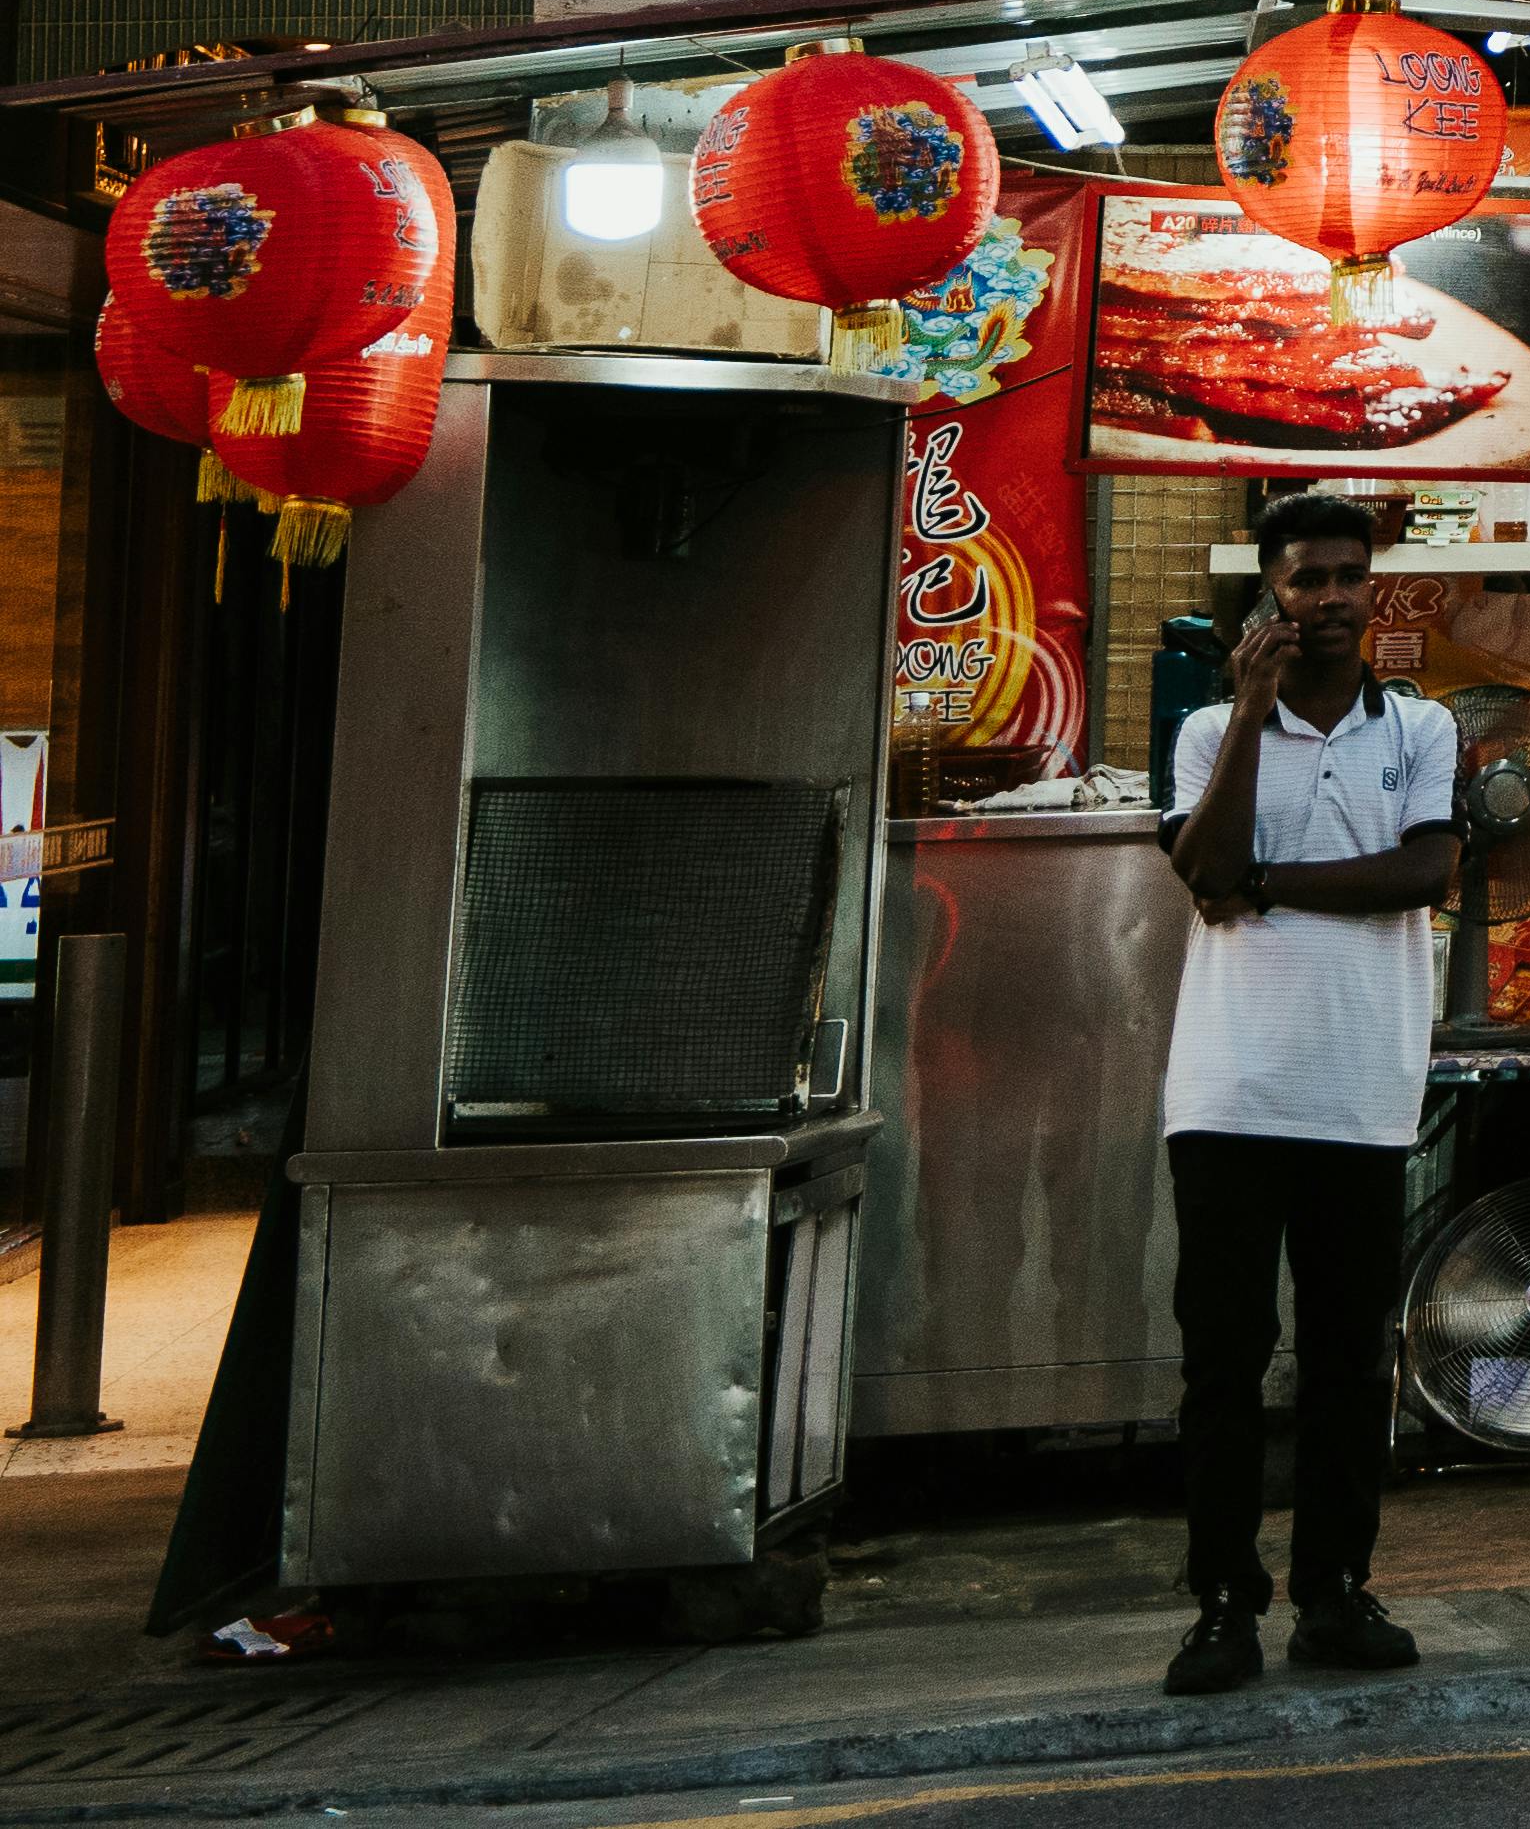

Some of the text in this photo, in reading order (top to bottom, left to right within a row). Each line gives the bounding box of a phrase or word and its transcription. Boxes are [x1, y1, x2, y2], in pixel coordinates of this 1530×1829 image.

[1374, 50, 1482, 96] LOONG
[1401, 97, 1480, 140] KEE
[1161, 214, 1196, 231] A20
